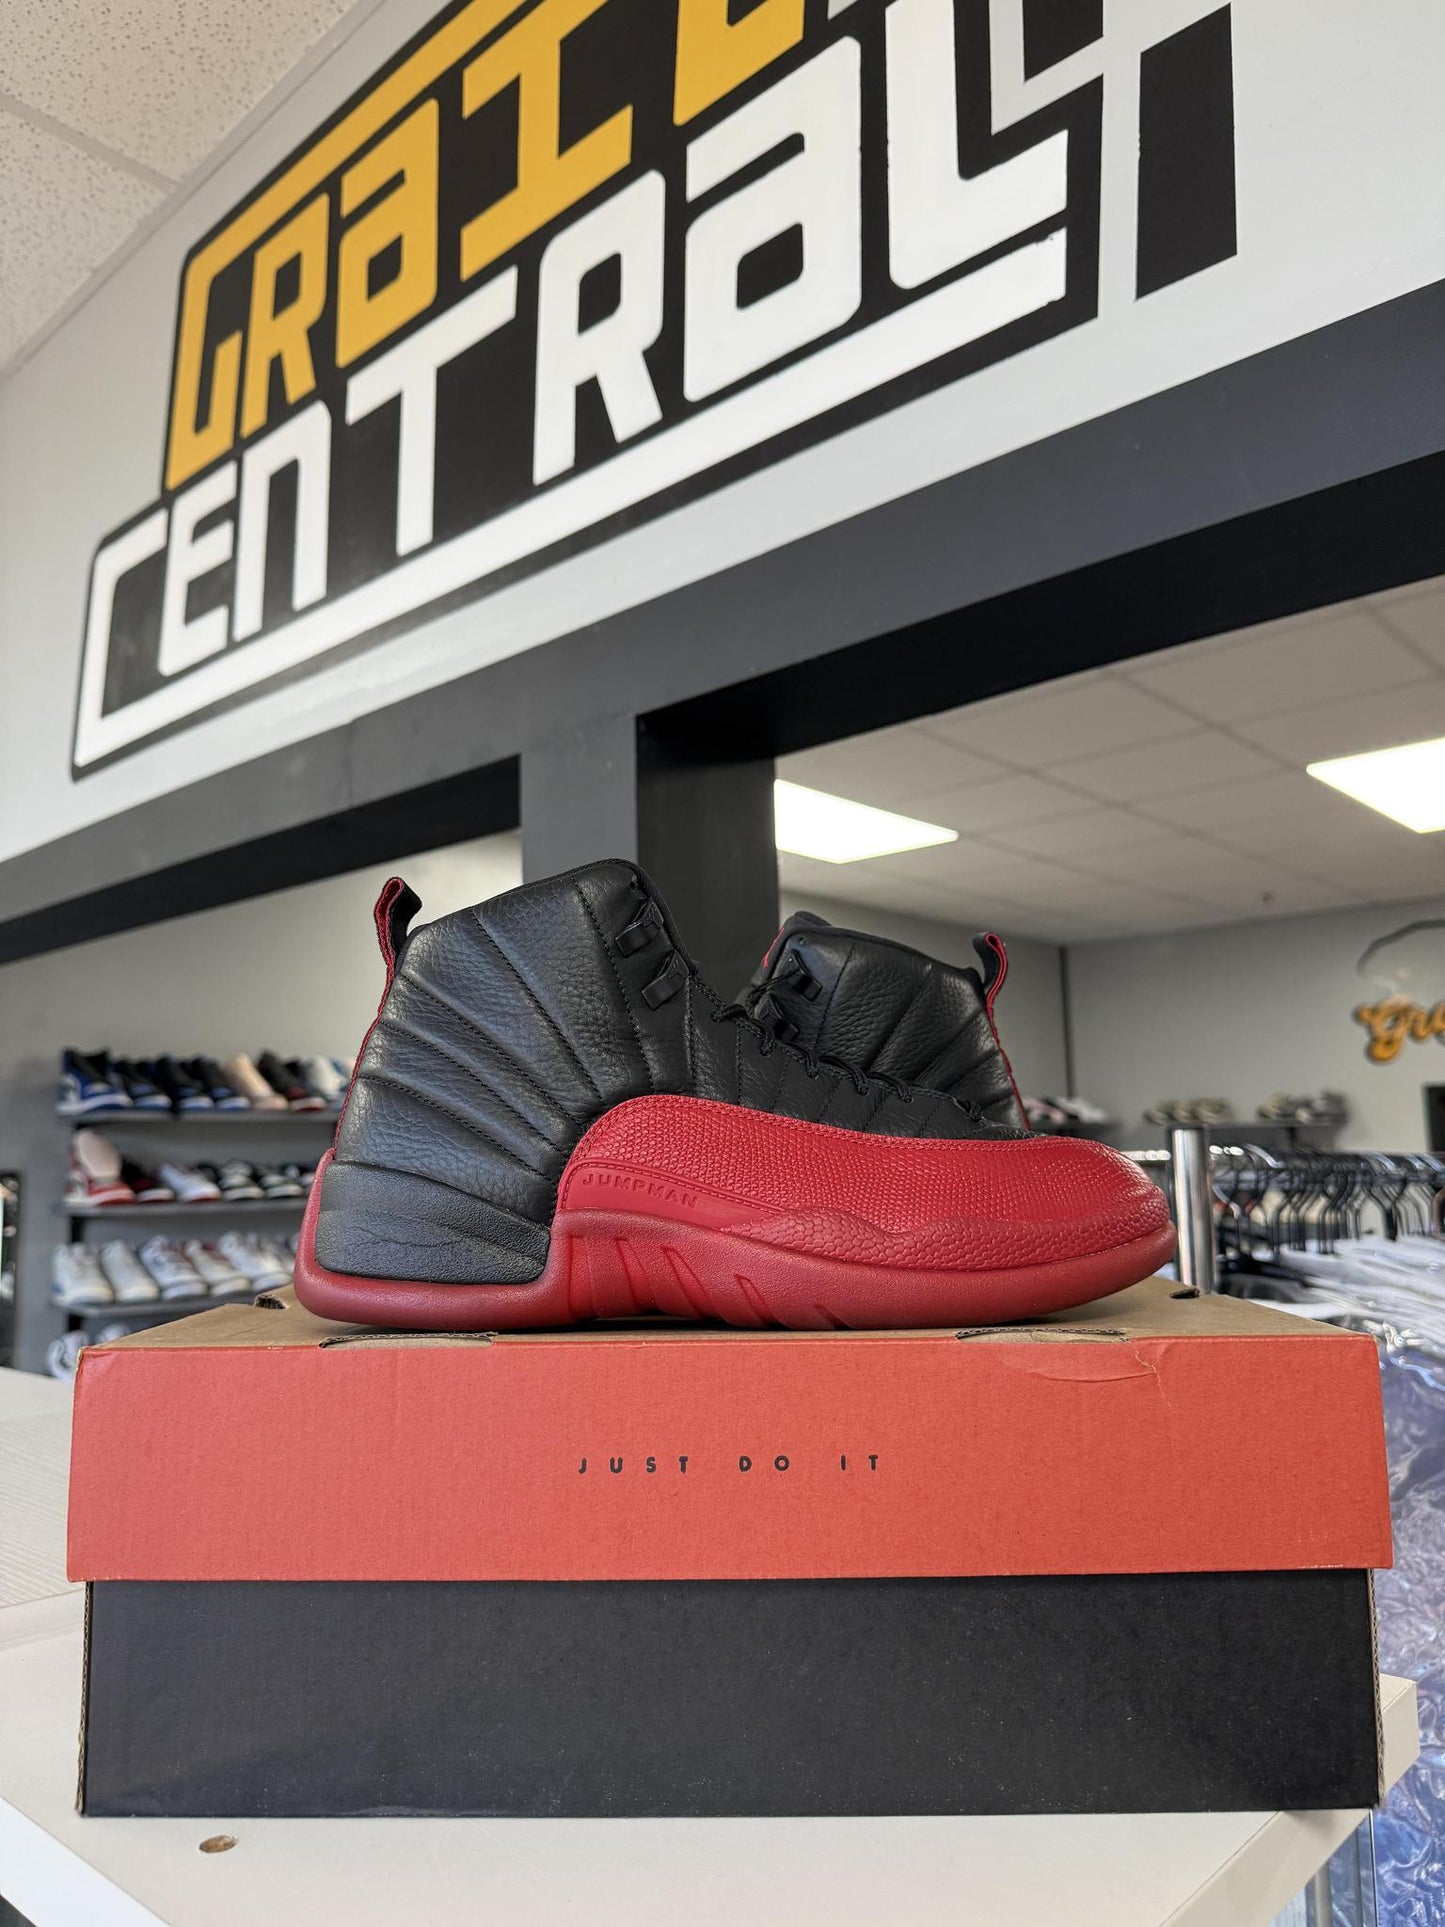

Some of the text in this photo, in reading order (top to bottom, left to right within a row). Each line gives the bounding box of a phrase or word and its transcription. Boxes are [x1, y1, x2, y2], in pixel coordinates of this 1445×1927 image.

[582, 1173, 698, 1208] JUMPMAN
[578, 1454, 879, 1474] JUST DO IT
